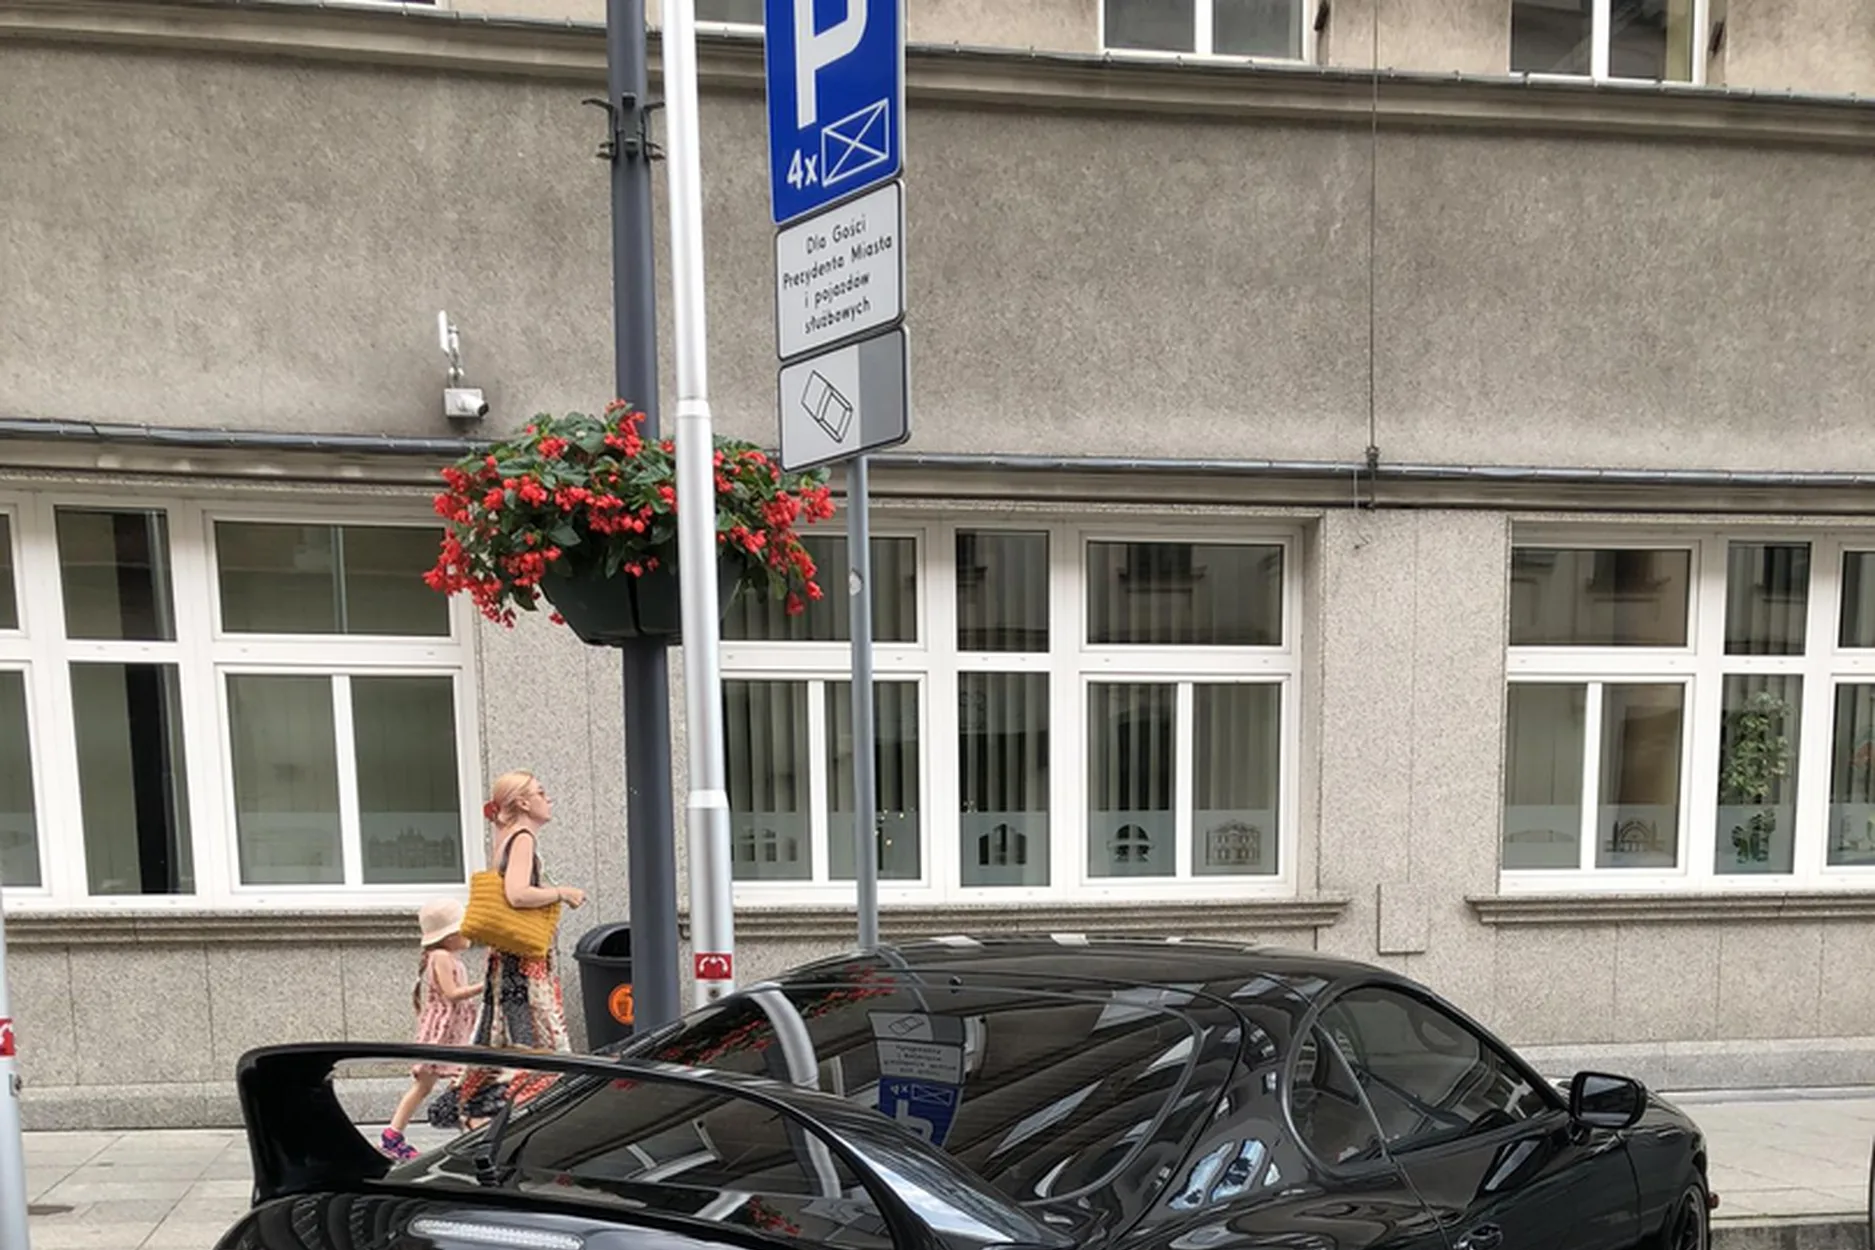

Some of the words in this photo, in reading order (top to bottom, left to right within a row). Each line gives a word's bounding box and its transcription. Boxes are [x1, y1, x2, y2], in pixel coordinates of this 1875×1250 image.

[793, 0, 869, 130] P
[787, 148, 818, 190] 4x
[806, 234, 827, 255] Dla
[832, 213, 866, 243] Gości
[782, 256, 845, 290] Prezydenta
[851, 236, 892, 263] Miasta
[804, 291, 809, 308] i
[815, 271, 870, 309] pojazdów
[804, 296, 871, 334] służbowych
